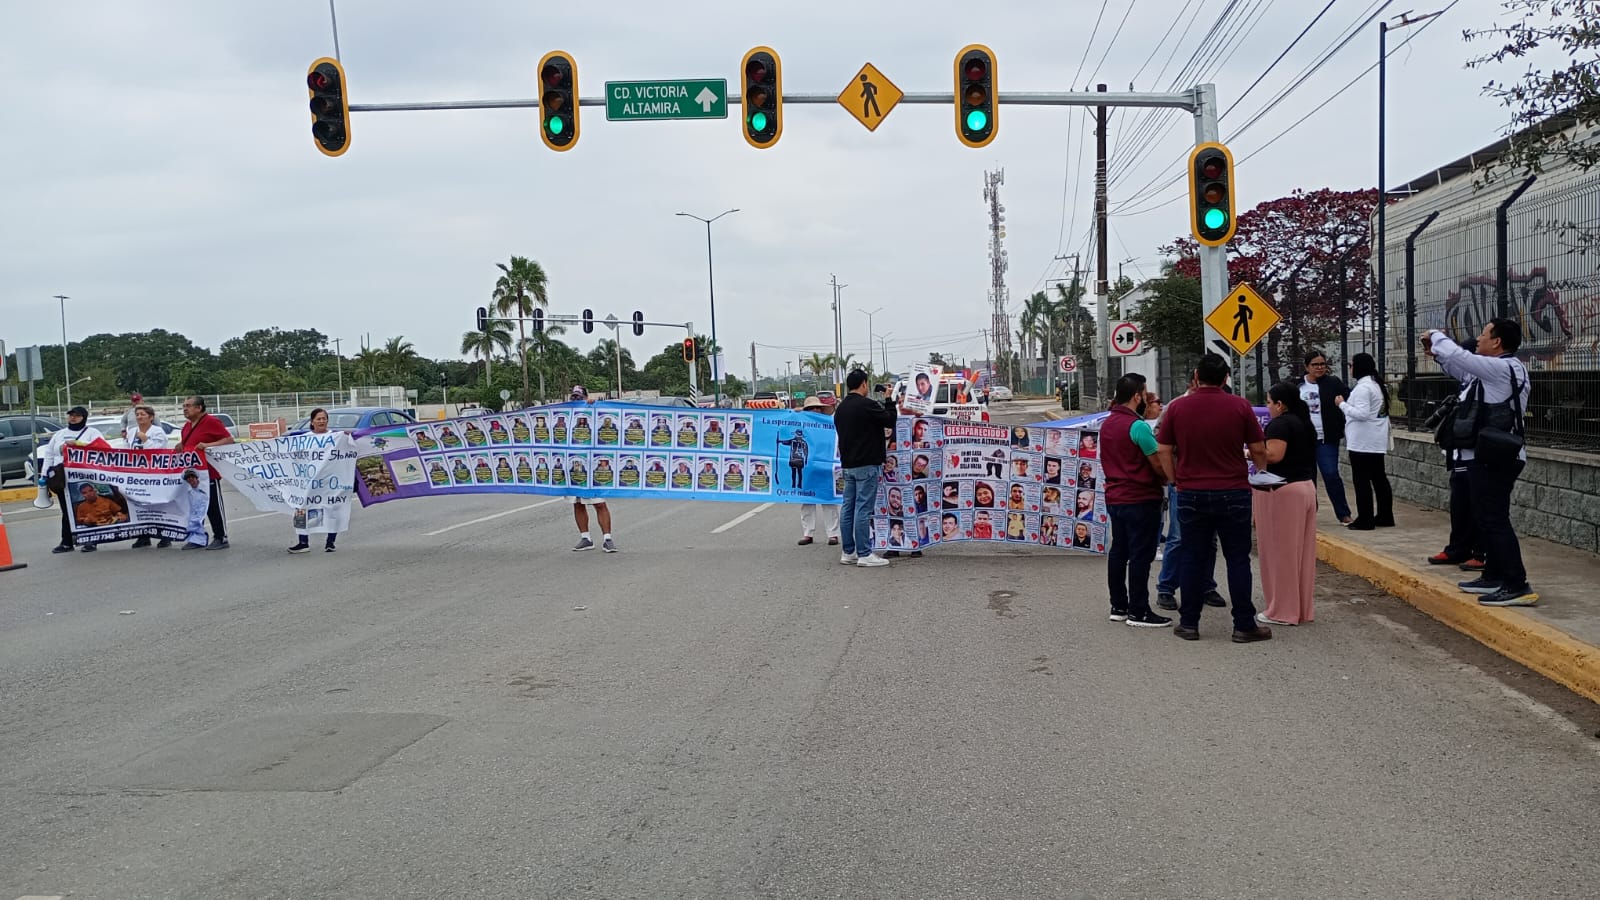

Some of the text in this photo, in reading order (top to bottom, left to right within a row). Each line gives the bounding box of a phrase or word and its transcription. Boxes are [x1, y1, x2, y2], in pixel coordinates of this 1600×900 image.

[614, 86, 688, 99] CD. VICTORIA
[622, 102, 681, 114] ALTAMIRA
[762, 417, 771, 425] La
[771, 419, 802, 428] esperanza
[802, 421, 821, 430] puede
[946, 426, 1006, 438] DESAPARECIDOS
[275, 435, 336, 454] MARINA
[950, 437, 981, 445] TAMAULIPAS
[981, 438, 1009, 446] ALTAMIRA
[67, 448, 84, 464] MI
[87, 450, 148, 469] FAMILIA
[151, 454, 169, 469] ME
[234, 453, 262, 466] APOYE
[311, 451, 325, 461] DE
[344, 450, 358, 459] AÑO
[67, 471, 97, 482] Miguel
[126, 475, 161, 487] Becerra
[311, 479, 324, 490] DE
[776, 488, 790, 497] Que
[797, 489, 816, 497] miedo
[306, 495, 322, 505] NO
[327, 495, 348, 505] HAY
